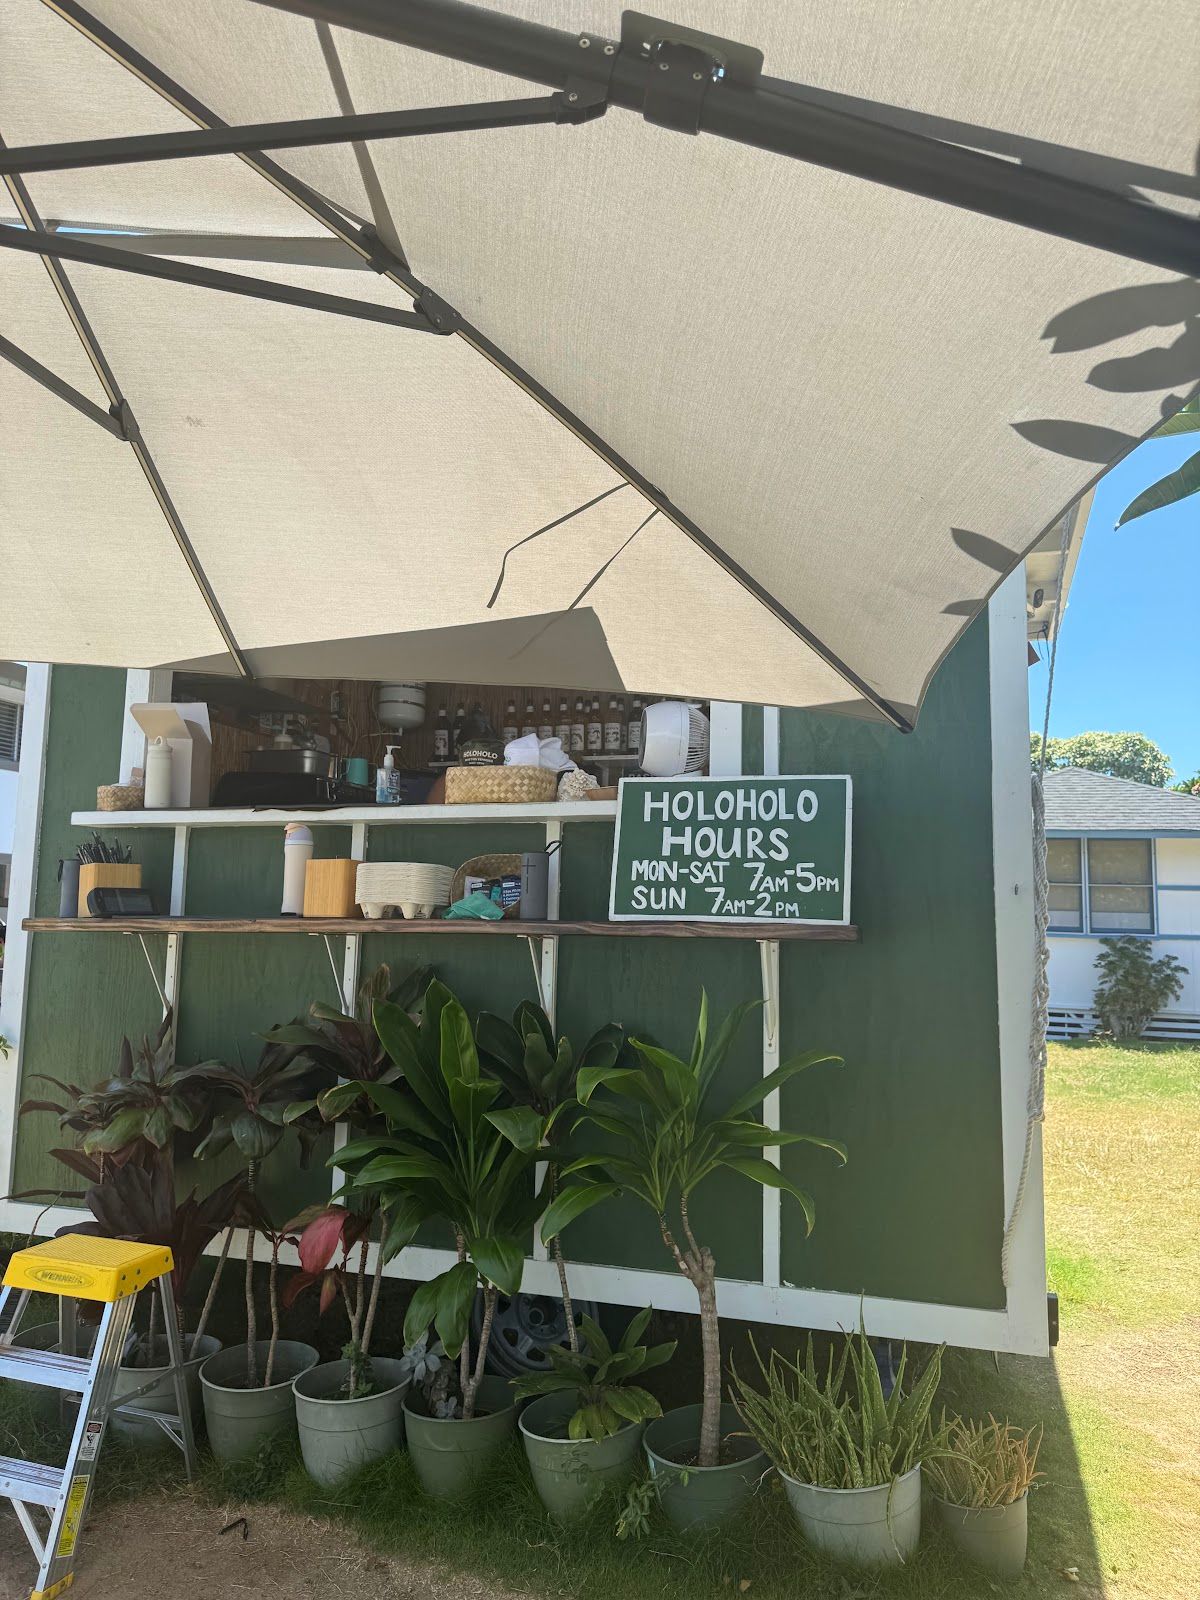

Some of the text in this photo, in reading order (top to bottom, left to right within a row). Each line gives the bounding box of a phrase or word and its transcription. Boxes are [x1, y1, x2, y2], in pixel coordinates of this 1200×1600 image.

[643, 788, 819, 822] HOLOHOLO
[661, 827, 789, 861] HOURS
[631, 860, 840, 893] MON-SAT 7AM-5PM
[631, 885, 687, 911] SUN
